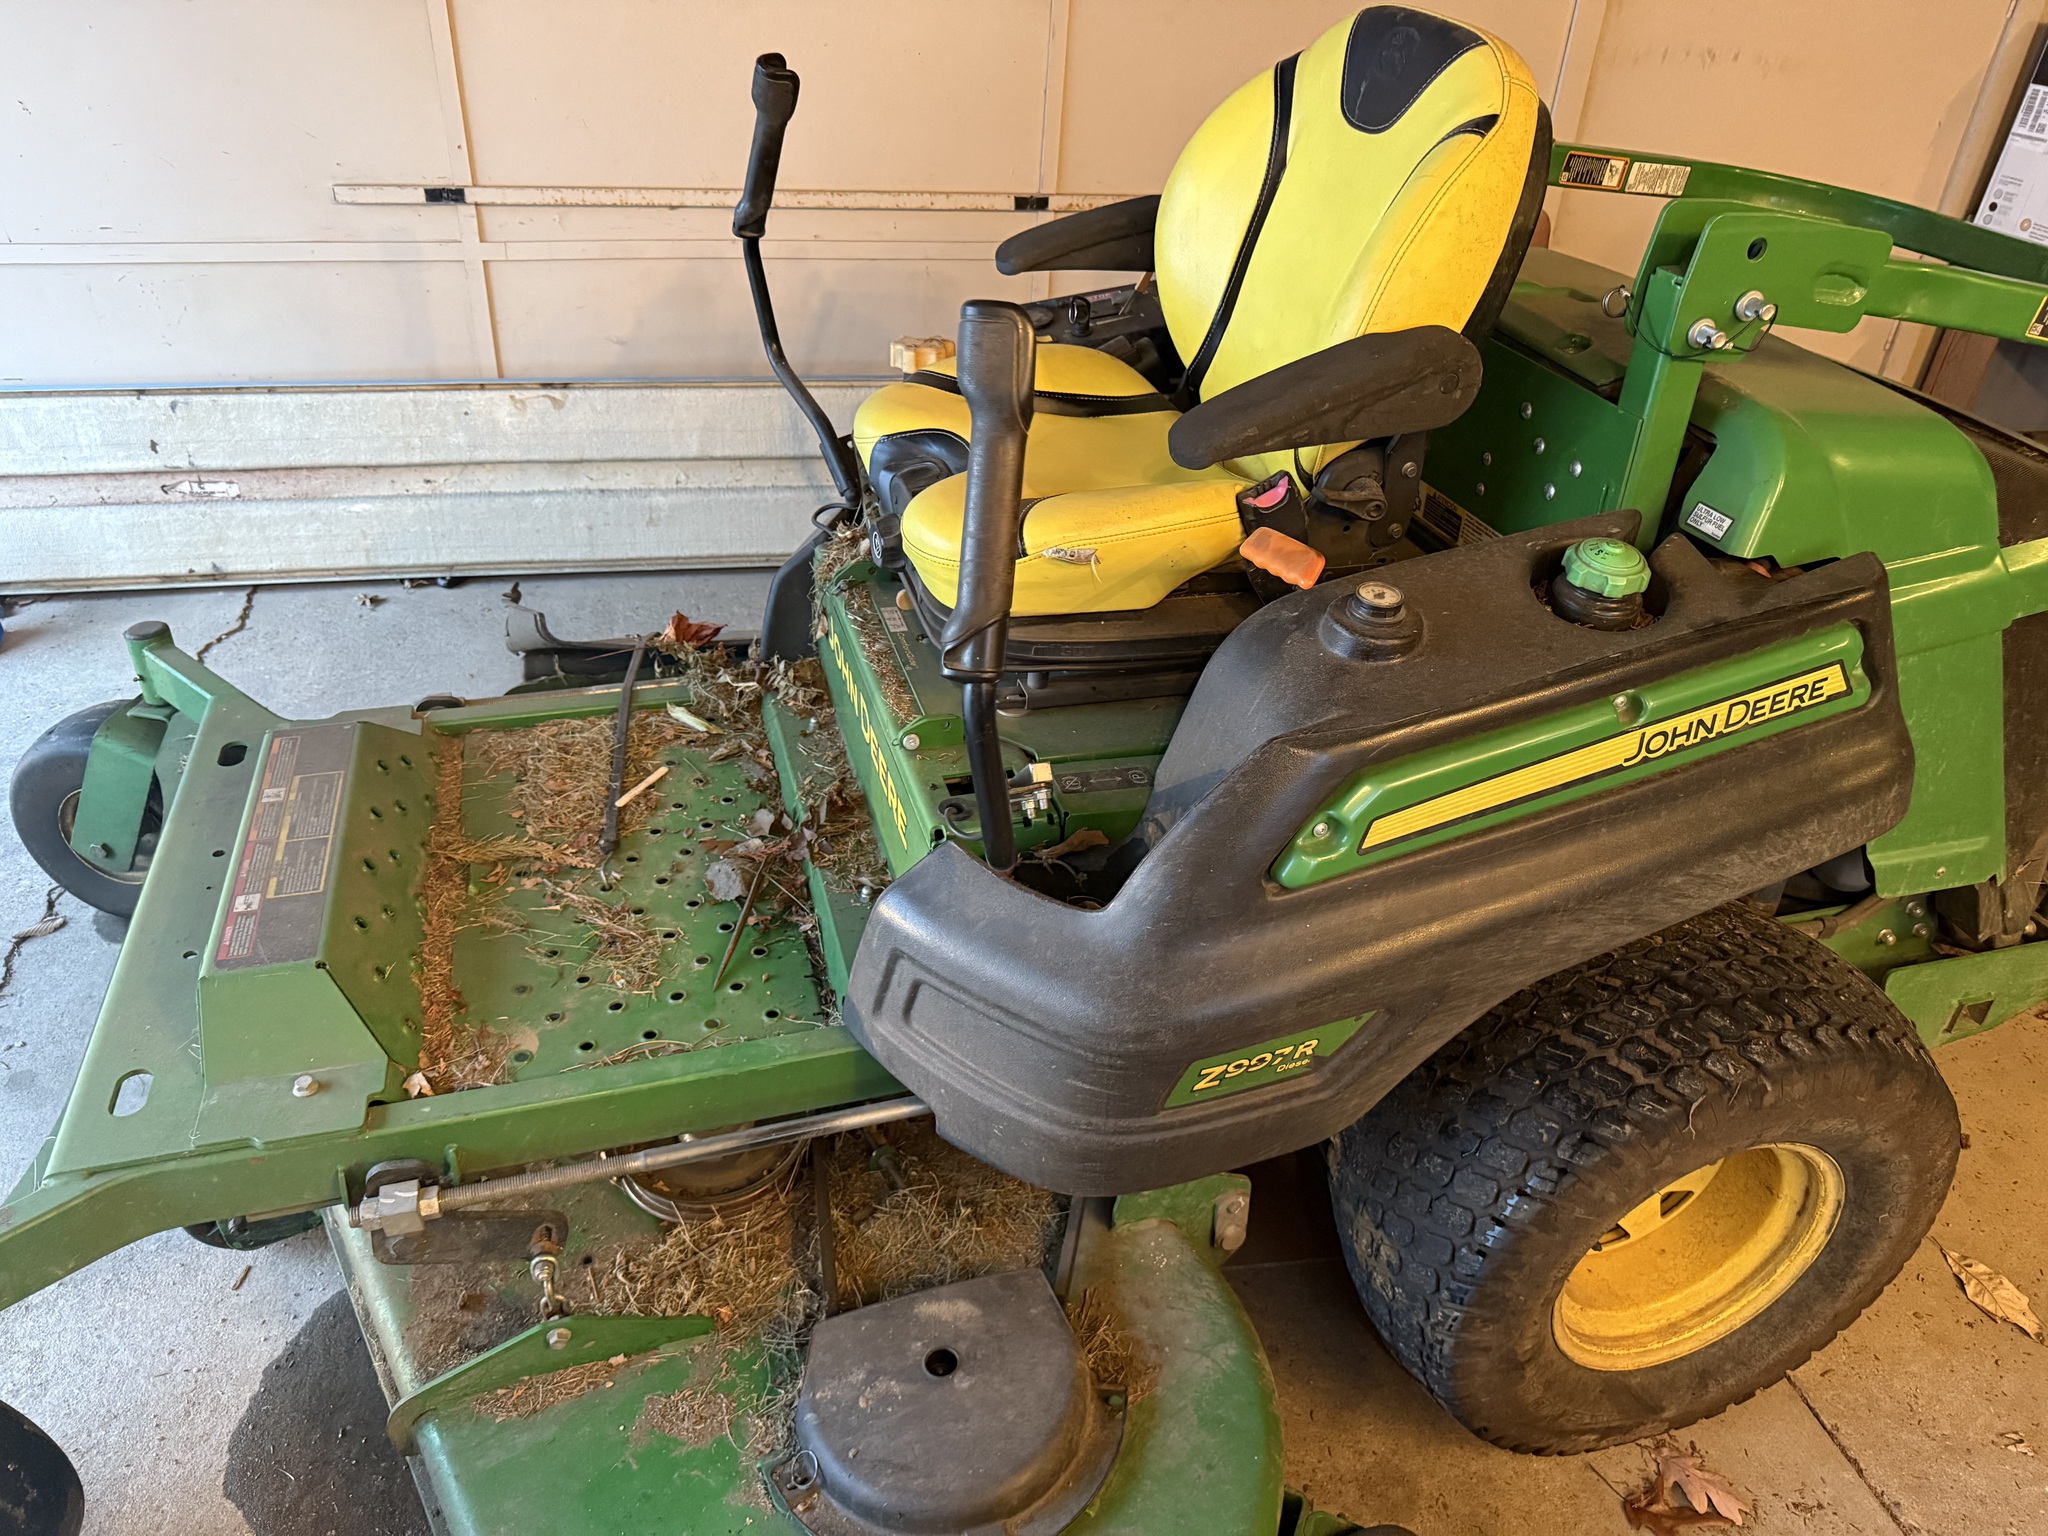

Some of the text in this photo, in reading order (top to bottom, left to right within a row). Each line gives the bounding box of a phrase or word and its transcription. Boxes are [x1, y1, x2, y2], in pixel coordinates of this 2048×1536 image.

[1689, 516, 1704, 527] ONLY
[1693, 510, 1725, 532] SULFUR FUEL
[1697, 505, 1727, 525] ULTRA LOW
[829, 616, 908, 851] JOHN DEERE
[1623, 676, 1829, 764] JOHN DEERE
[1191, 1039, 1319, 1092] Z997R
